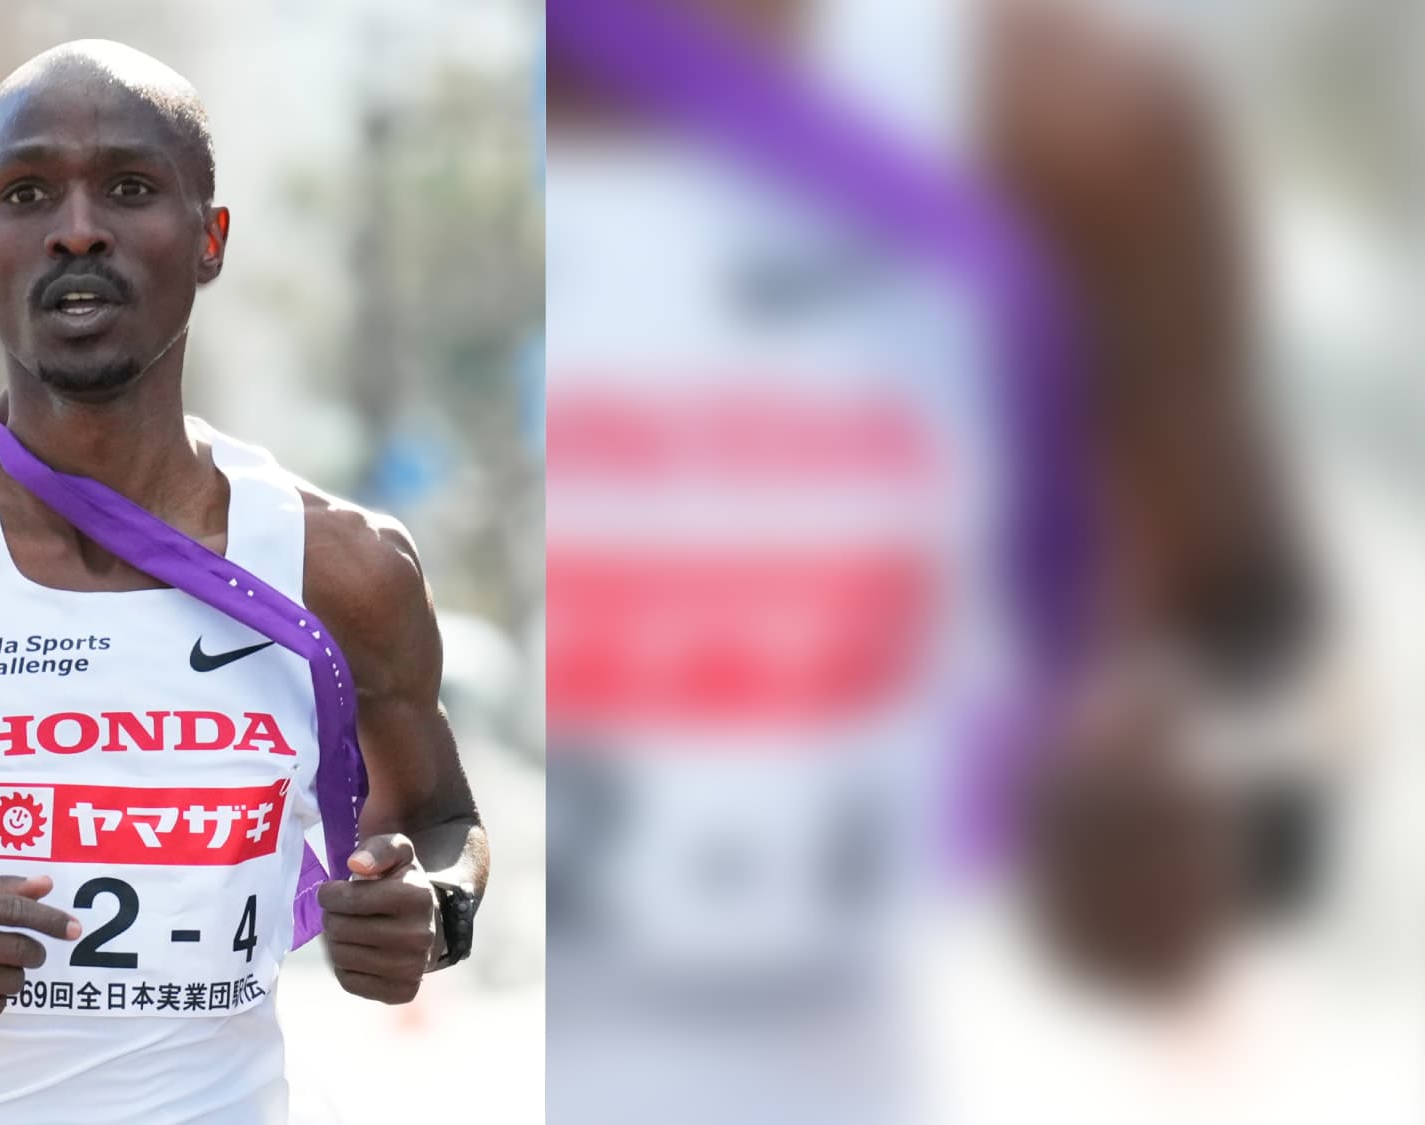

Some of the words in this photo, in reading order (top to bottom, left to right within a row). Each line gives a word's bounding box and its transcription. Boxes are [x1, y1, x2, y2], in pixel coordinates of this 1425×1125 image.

[24, 634, 111, 655] Sports
[68, 802, 274, 848] ヤマザキ
[69, 876, 140, 969] 2
[232, 894, 258, 963] 4
